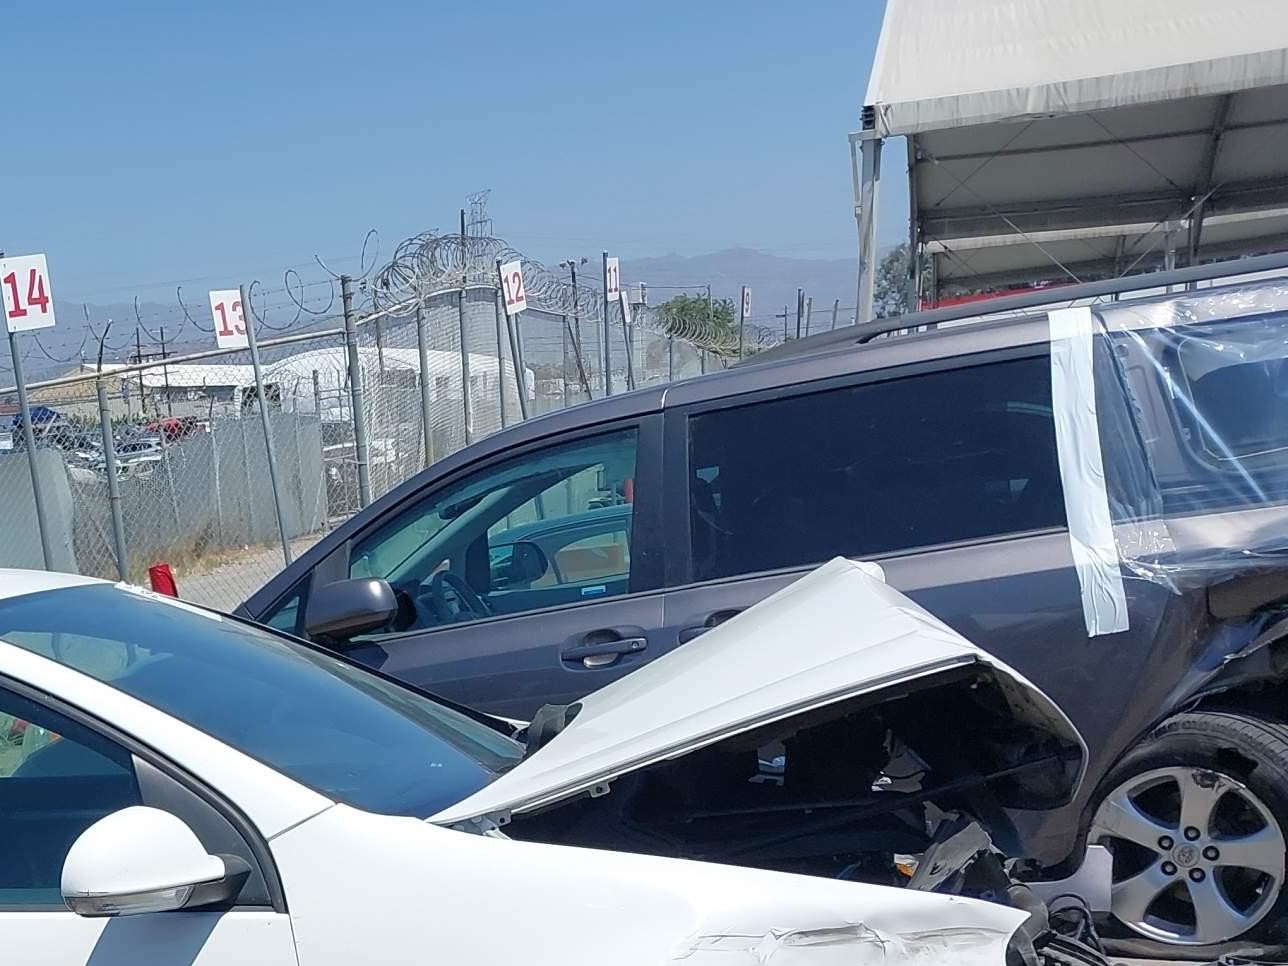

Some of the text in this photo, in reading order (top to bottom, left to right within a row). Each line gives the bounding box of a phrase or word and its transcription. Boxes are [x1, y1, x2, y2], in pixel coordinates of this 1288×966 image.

[3, 269, 49, 318] 14
[503, 271, 524, 306] 12
[607, 266, 618, 293] 11
[215, 301, 246, 336] 13
